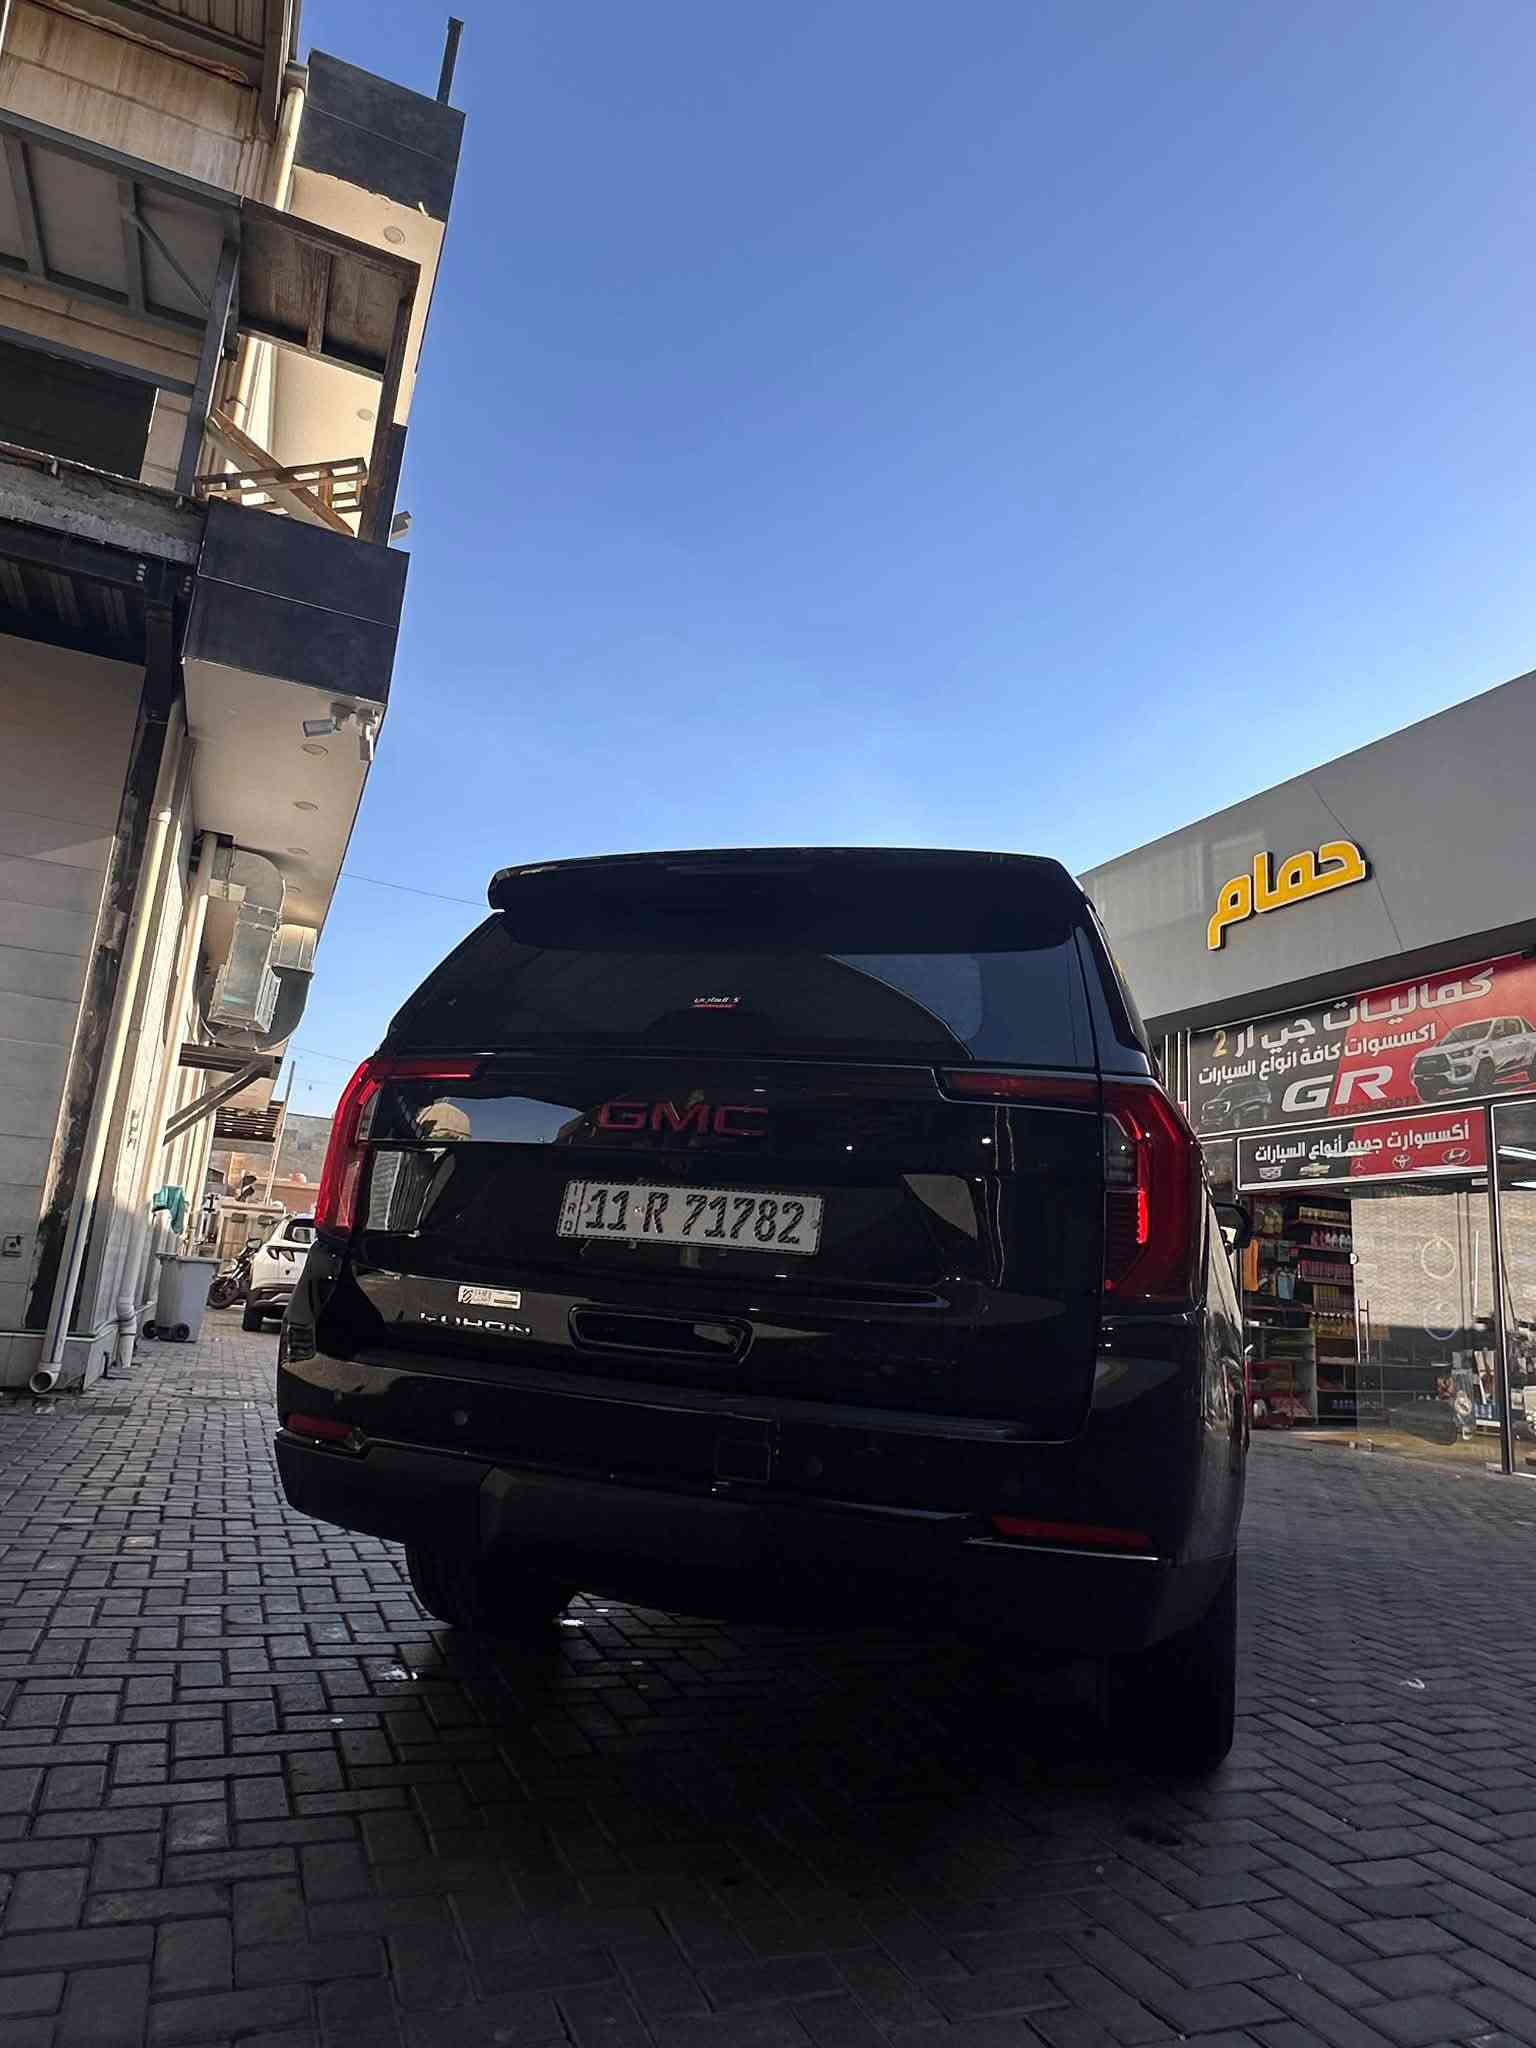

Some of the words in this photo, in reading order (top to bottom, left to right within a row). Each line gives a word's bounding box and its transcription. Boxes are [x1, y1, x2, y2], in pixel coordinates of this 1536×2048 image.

[1207, 840, 1366, 950] حمام
[1322, 967, 1495, 1032] كماليات
[1212, 1029, 1228, 1058] 2
[1260, 1017, 1316, 1055] جي
[1299, 1041, 1342, 1066] كافة
[1198, 1059, 1256, 1087] السيارات
[1281, 1065, 1393, 1112] GR
[599, 1101, 769, 1136] GMC
[1255, 1141, 1306, 1164] السيارات
[585, 1189, 630, 1232] 11
[642, 1191, 670, 1234] R
[682, 1193, 806, 1245] 71782
